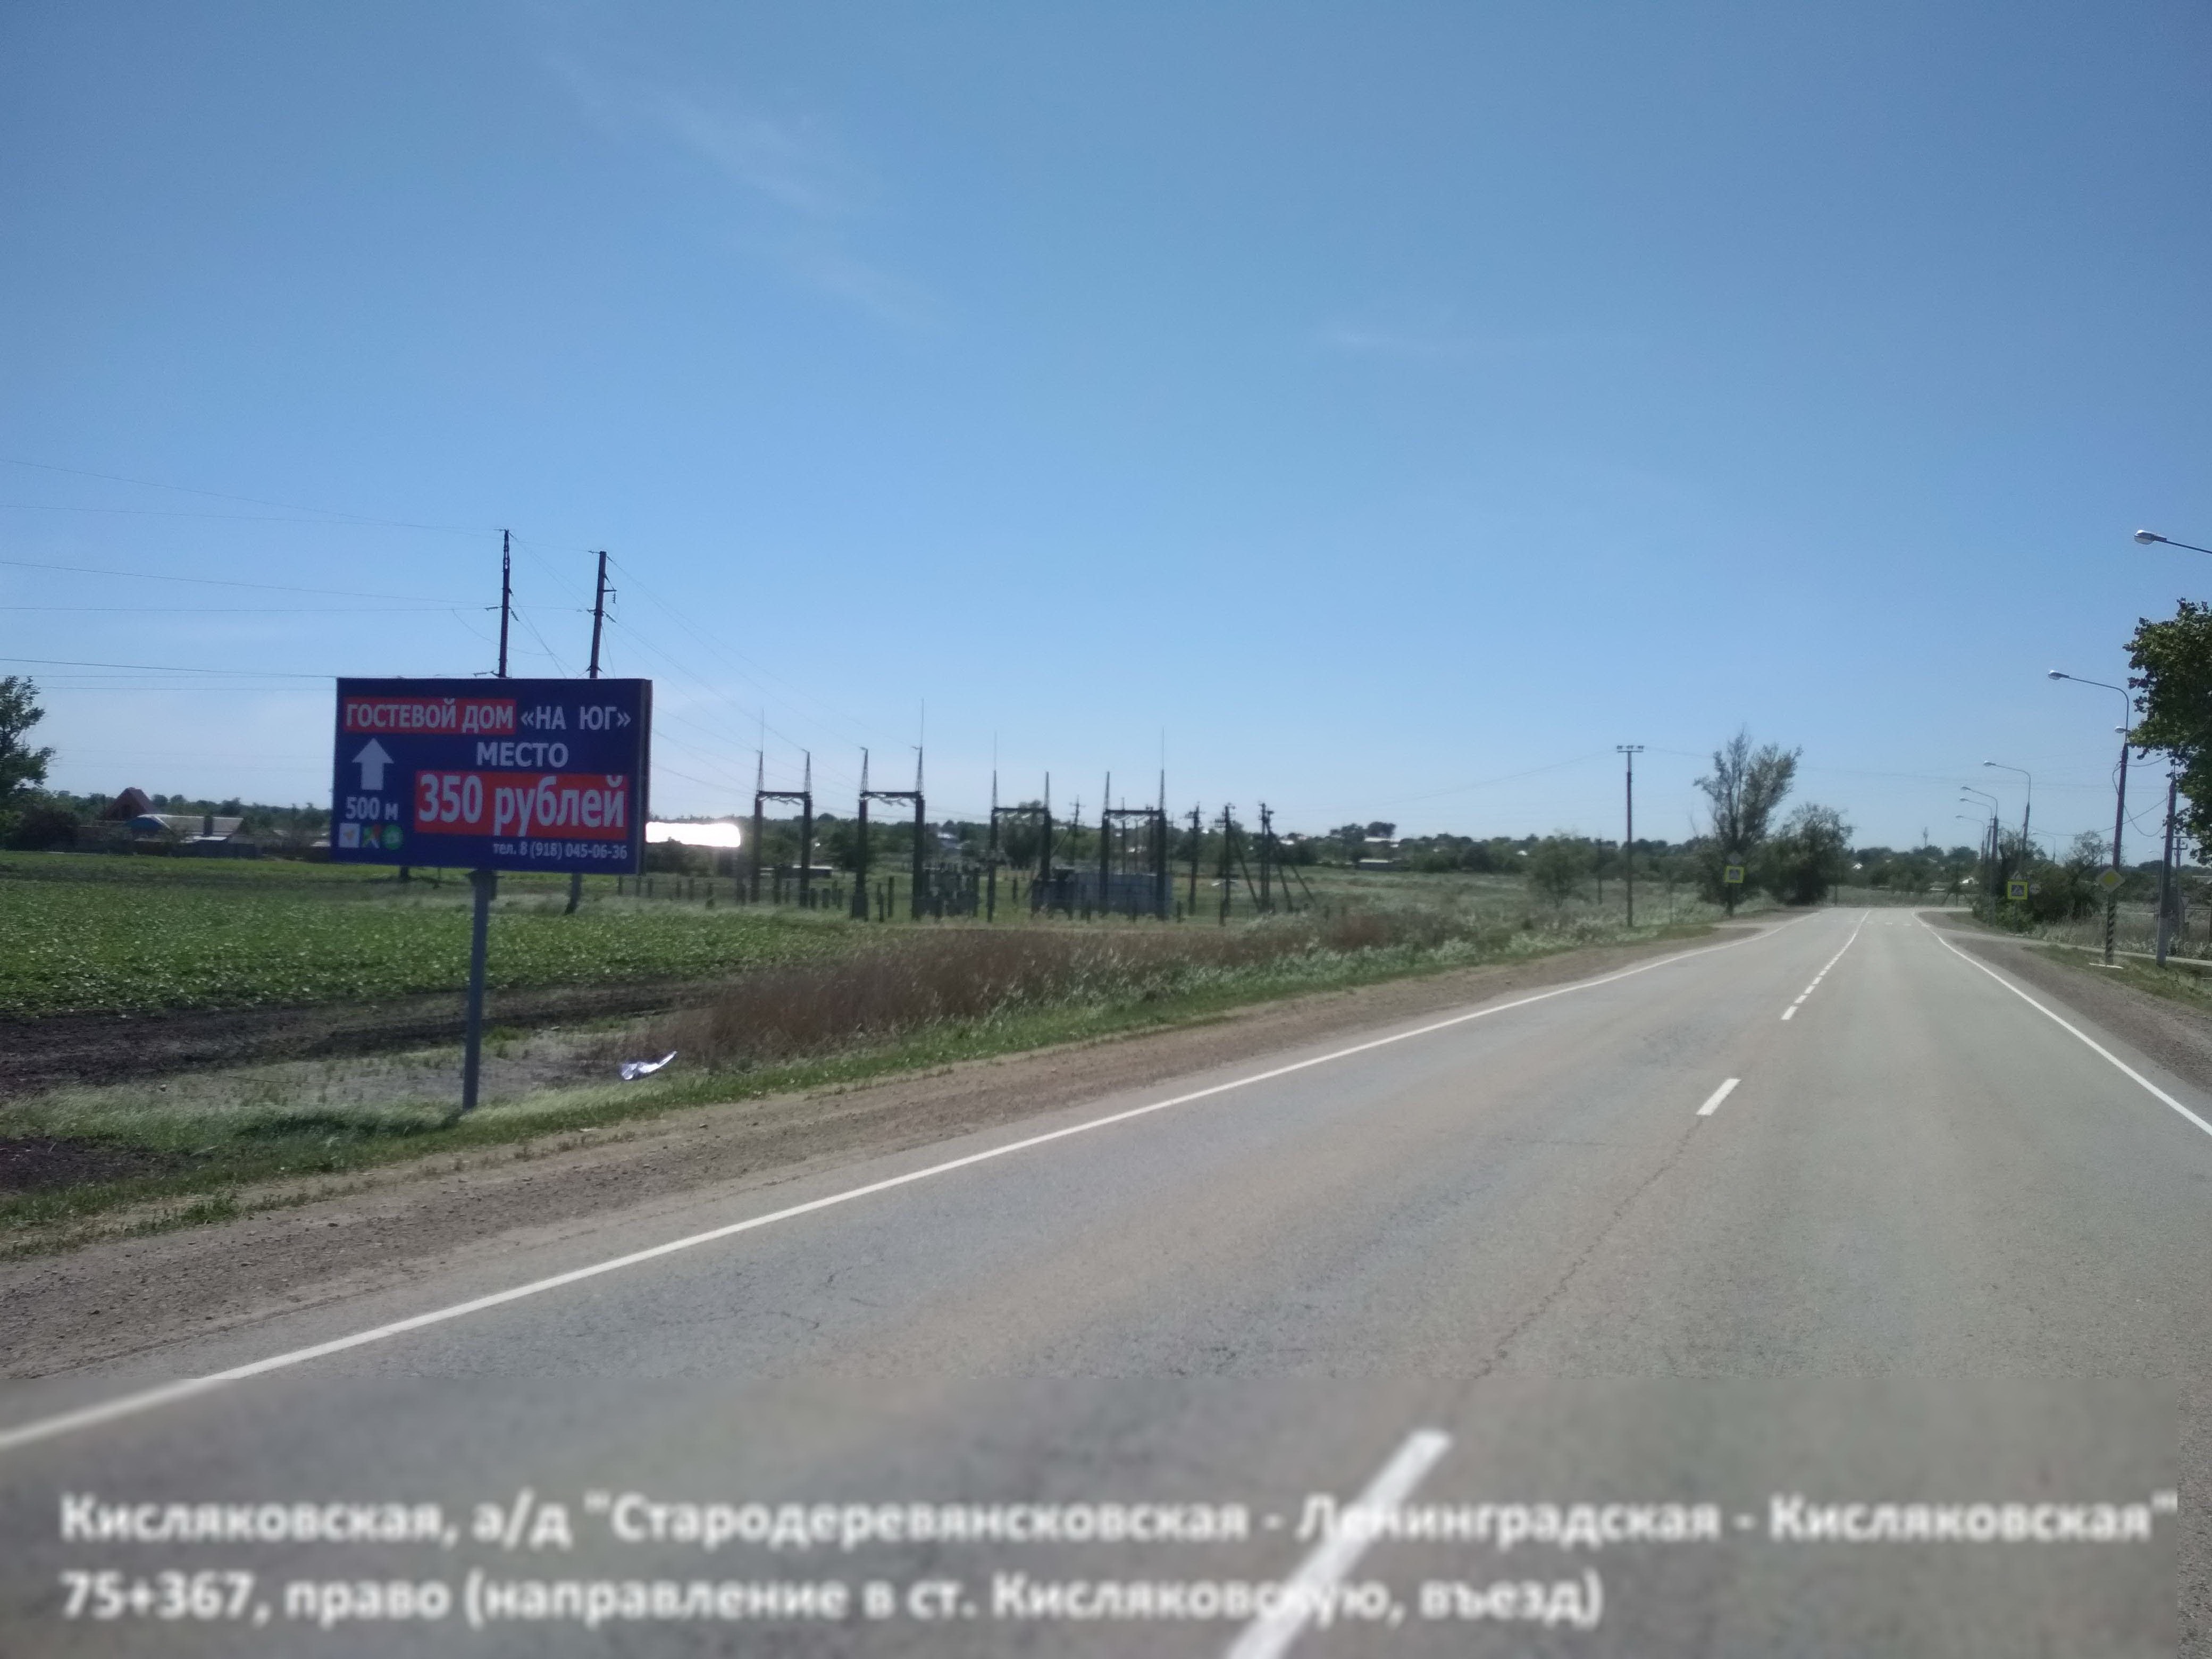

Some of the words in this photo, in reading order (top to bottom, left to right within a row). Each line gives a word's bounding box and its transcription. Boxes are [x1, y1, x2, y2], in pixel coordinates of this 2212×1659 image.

[346, 698, 456, 728] ГОСТЕВОЙ
[461, 705, 513, 733] ДОМ
[521, 706, 566, 730] «НА
[579, 706, 632, 730] ЮГ»
[477, 742, 568, 768] МЕСТО
[345, 797, 380, 819] 500
[418, 775, 483, 824] 350
[493, 775, 625, 837] рублей
[493, 842, 516, 855] тел.
[518, 841, 528, 856] 8
[565, 843, 628, 859] 045-06-36
